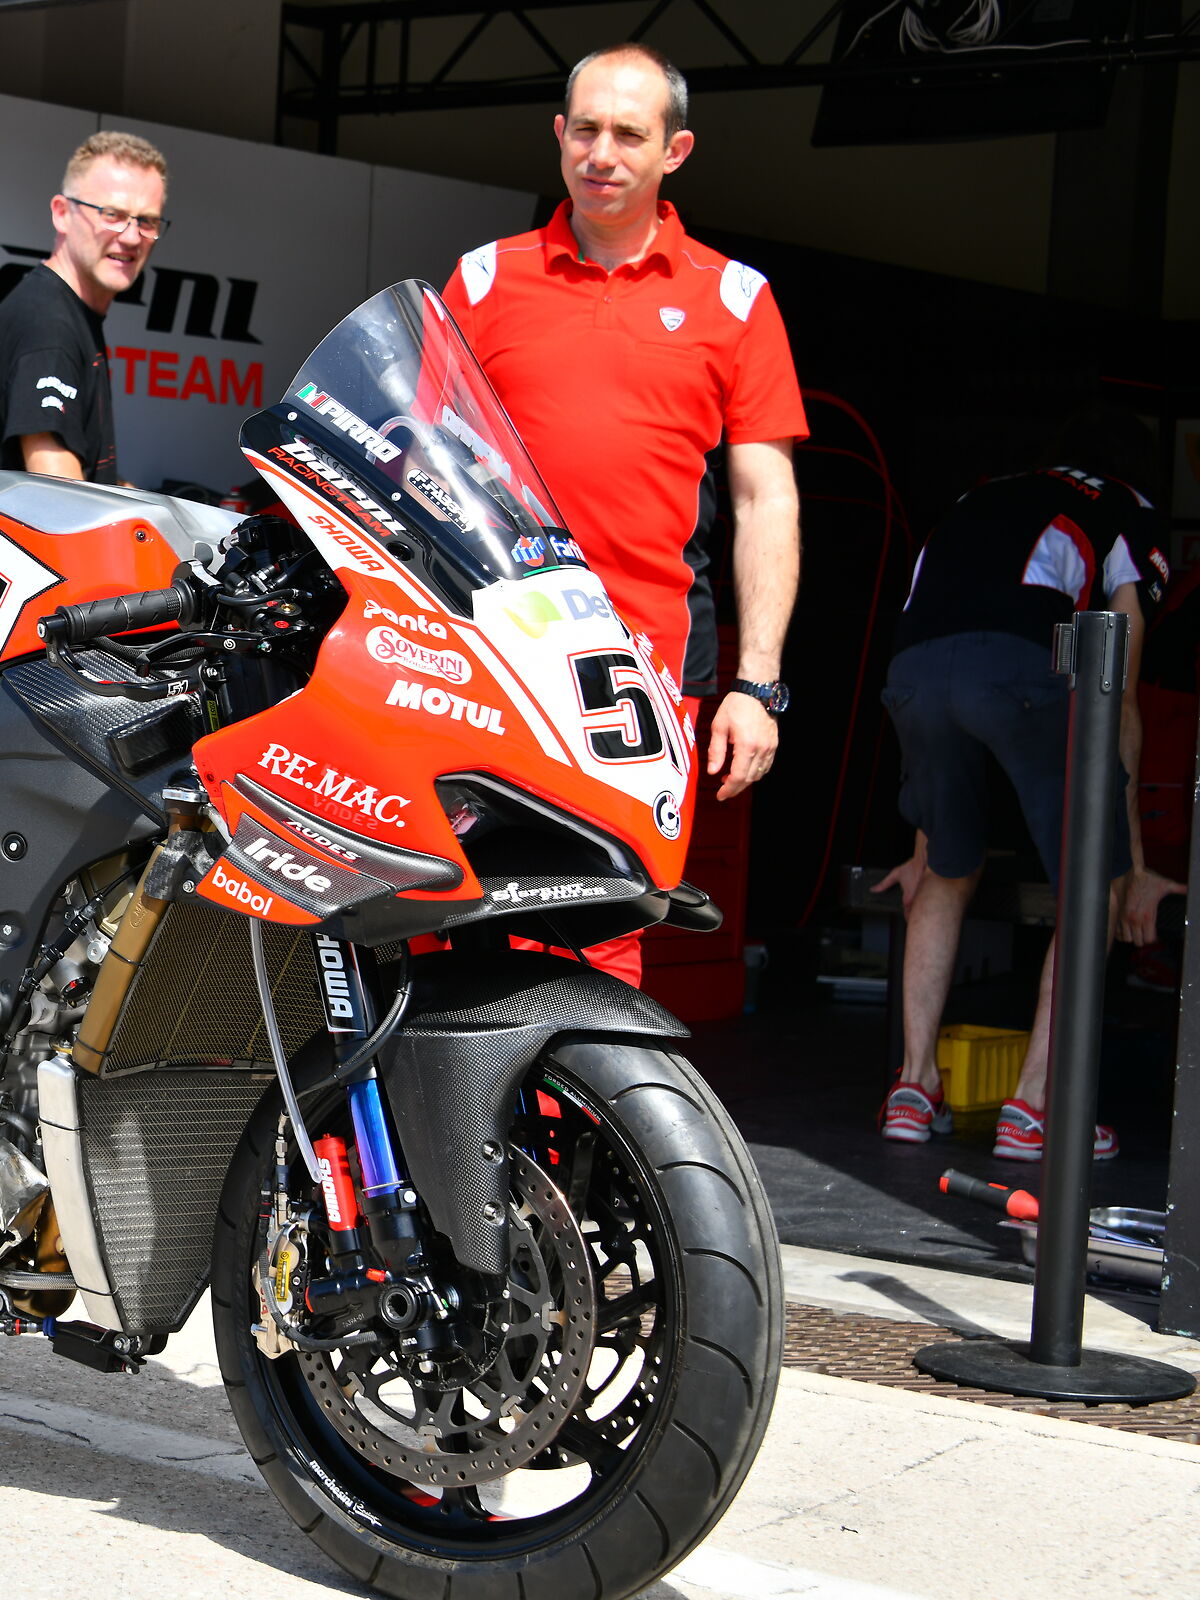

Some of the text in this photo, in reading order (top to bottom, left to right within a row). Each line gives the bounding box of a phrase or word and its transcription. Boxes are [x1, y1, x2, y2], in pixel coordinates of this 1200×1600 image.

[267, 446, 394, 538] RACINGTEAM
[307, 514, 385, 572] SHOWA
[375, 629, 464, 682] SOVERINI
[385, 679, 506, 736] MOTUL
[257, 742, 412, 828] RE.MAC.
[212, 865, 273, 916] babol
[243, 837, 333, 893] Iride
[315, 932, 354, 1019] HOWA
[317, 1157, 342, 1223] SHOWA
[309, 1460, 354, 1509] marchesini
